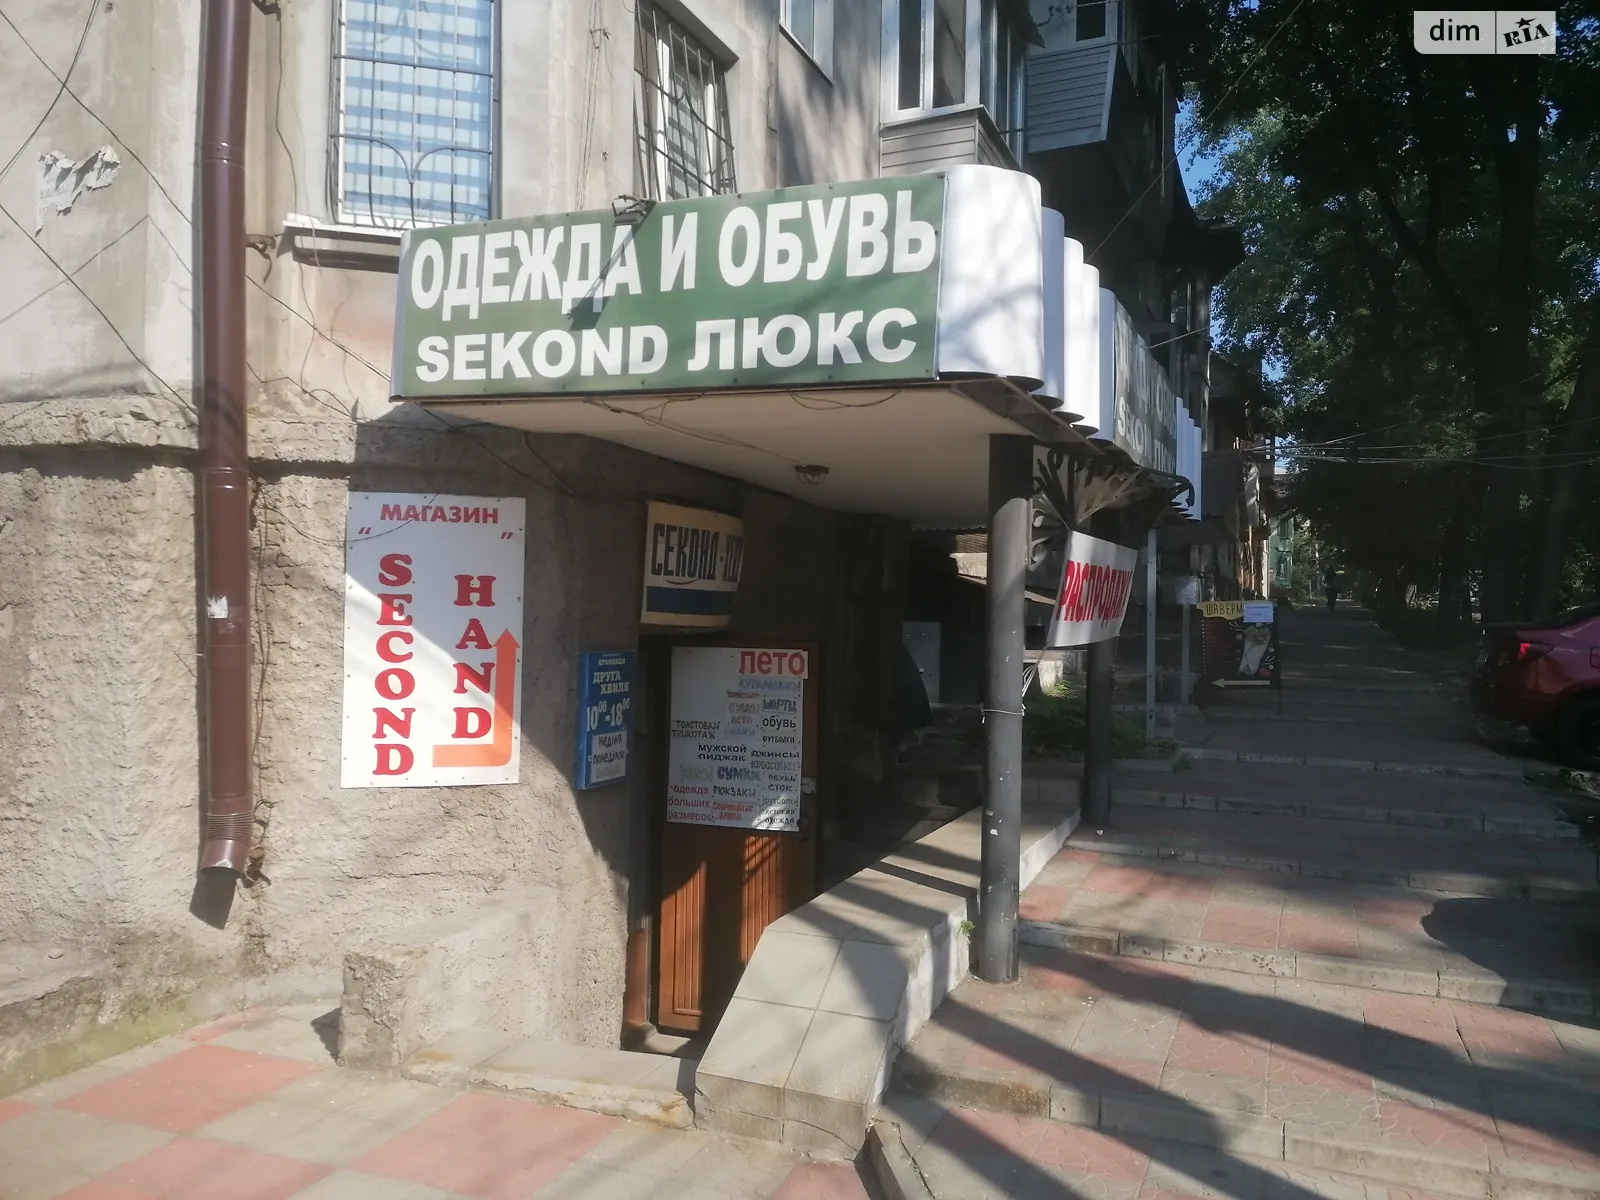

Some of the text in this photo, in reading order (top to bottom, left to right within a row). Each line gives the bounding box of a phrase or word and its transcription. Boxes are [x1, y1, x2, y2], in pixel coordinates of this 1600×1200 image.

[411, 189, 939, 321] ОДЕЖДА И ОБУВЬ
[415, 308, 917, 383] SEKOND ЛЮКС
[380, 504, 499, 524] МАГАЗИН
[1206, 603, 1243, 616] ШАВЕРМ
[451, 574, 496, 739] HAND
[372, 553, 416, 775] SECOND
[593, 671, 621, 684] ДРУГА
[600, 682, 629, 694] ХВИЛЯ
[676, 720, 720, 731] ТОЛСТОВКИ
[762, 715, 797, 730] обувь
[672, 730, 716, 740] ТРИКОТАЖ
[698, 744, 747, 755] мужской
[751, 750, 799, 759] джинсы
[699, 753, 746, 762] пиджак
[673, 786, 709, 796] одежда
[713, 785, 756, 798] РЮКЗАКИ
[768, 784, 793, 792] СТОК
[668, 796, 710, 808] больших
[667, 810, 712, 821] размеров
